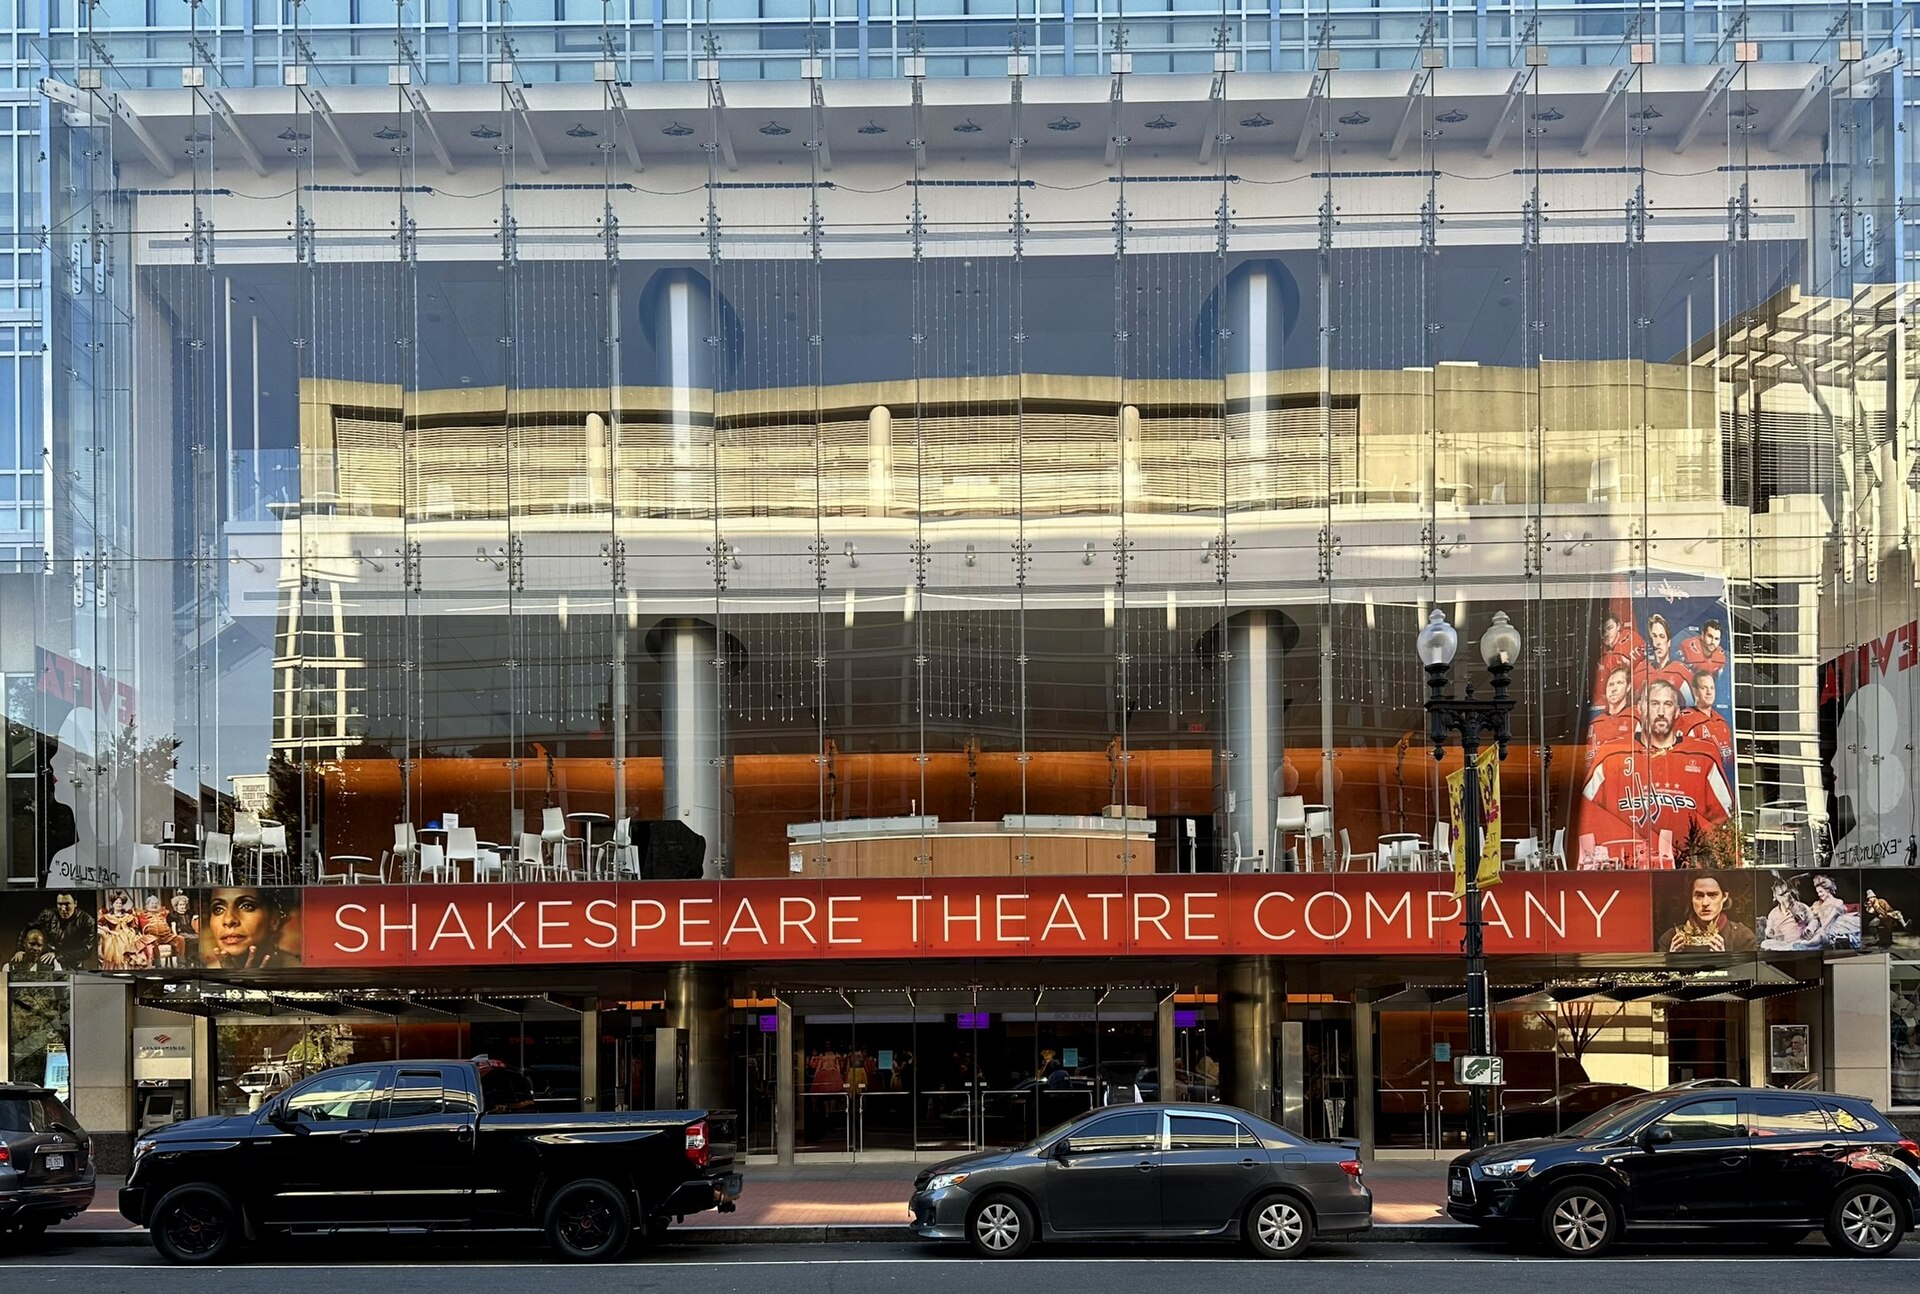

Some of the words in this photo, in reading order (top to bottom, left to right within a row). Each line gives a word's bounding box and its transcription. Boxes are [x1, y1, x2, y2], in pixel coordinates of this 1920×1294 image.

[333, 896, 863, 953] SHAKESPEARE
[896, 892, 1219, 942] THEATRE
[1253, 889, 1620, 940] COMPANY
[1491, 1058, 1501, 1068] 2
